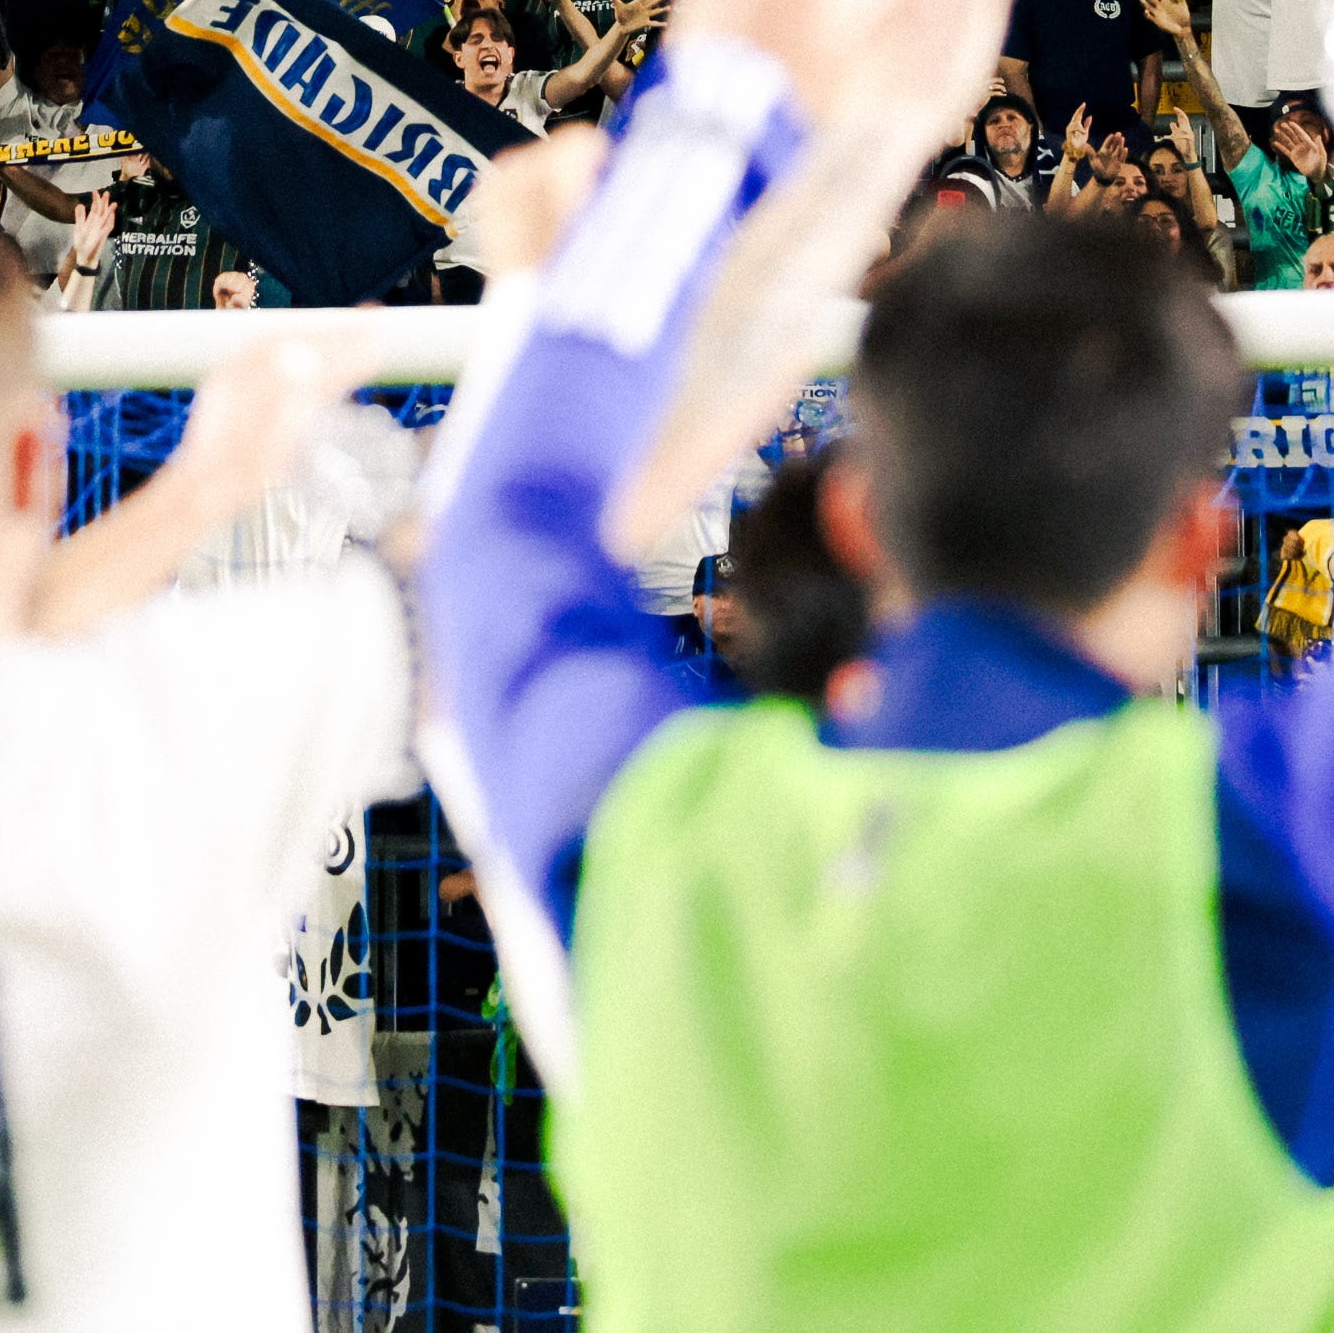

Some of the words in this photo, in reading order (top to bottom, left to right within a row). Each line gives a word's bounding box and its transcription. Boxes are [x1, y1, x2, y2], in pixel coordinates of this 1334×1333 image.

[97, 130, 141, 154] OU
[122, 232, 197, 245] HERBALIFE
[122, 243, 196, 257] NUTRITION
